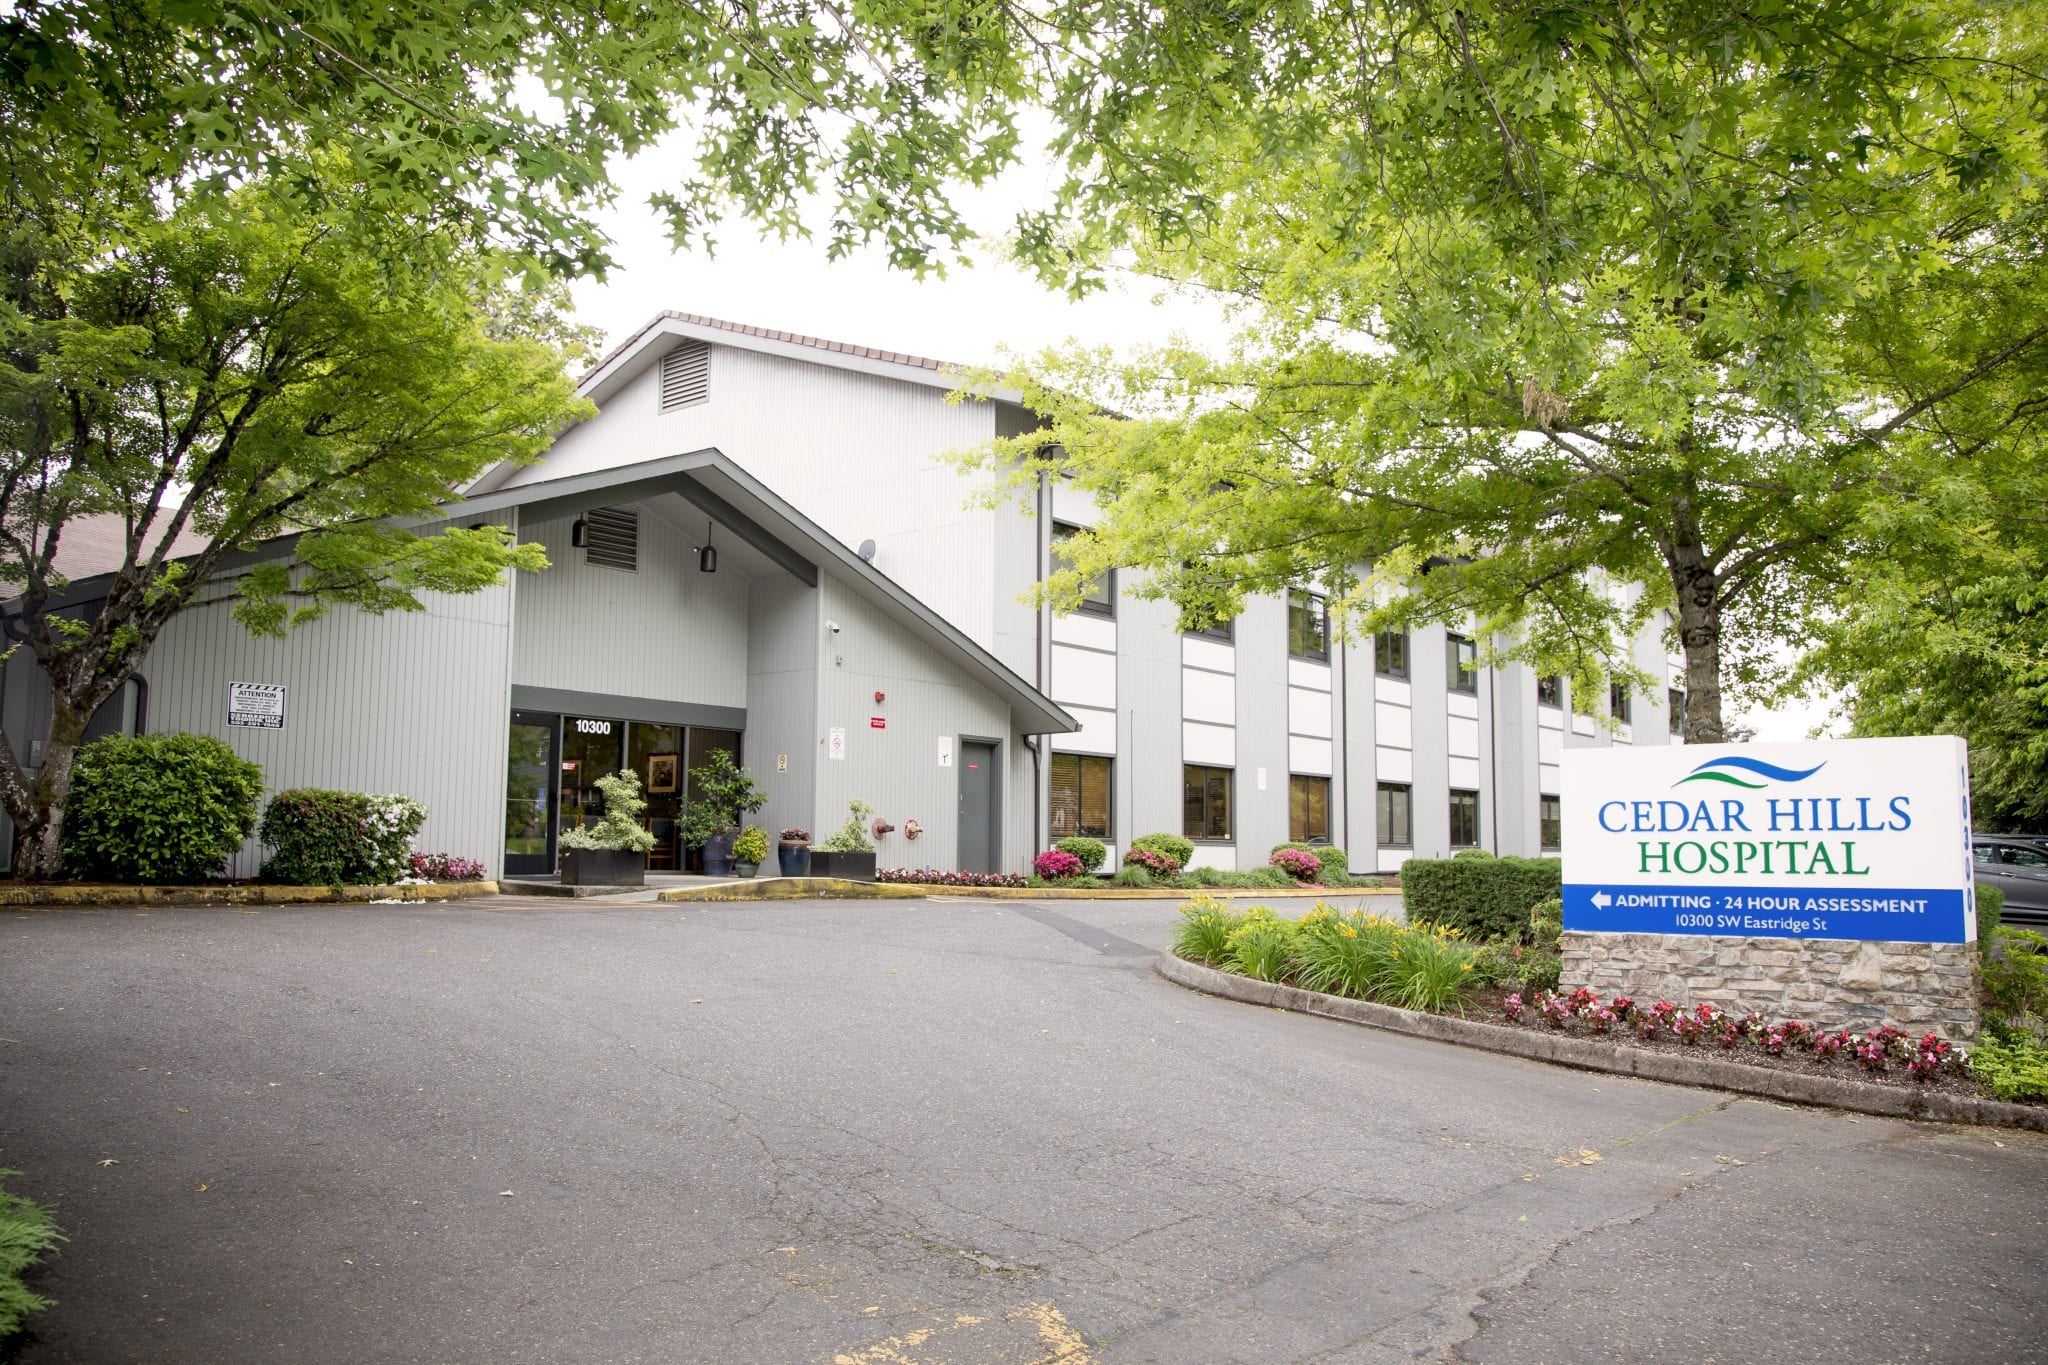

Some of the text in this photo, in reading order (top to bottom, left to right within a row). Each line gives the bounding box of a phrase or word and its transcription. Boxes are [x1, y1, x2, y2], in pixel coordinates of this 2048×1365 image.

[239, 690, 276, 698] ATTENTION
[576, 719, 611, 735] 10300
[1598, 796, 1912, 832] CEDAR HILLS
[1961, 765, 1973, 913] 10300
[1637, 840, 1870, 875] HOSPITAL
[1615, 894, 1929, 913] ADMITTING 24 HOUR ASSESSMENT
[1675, 914, 1827, 933] 10300 SW Eastridge St
